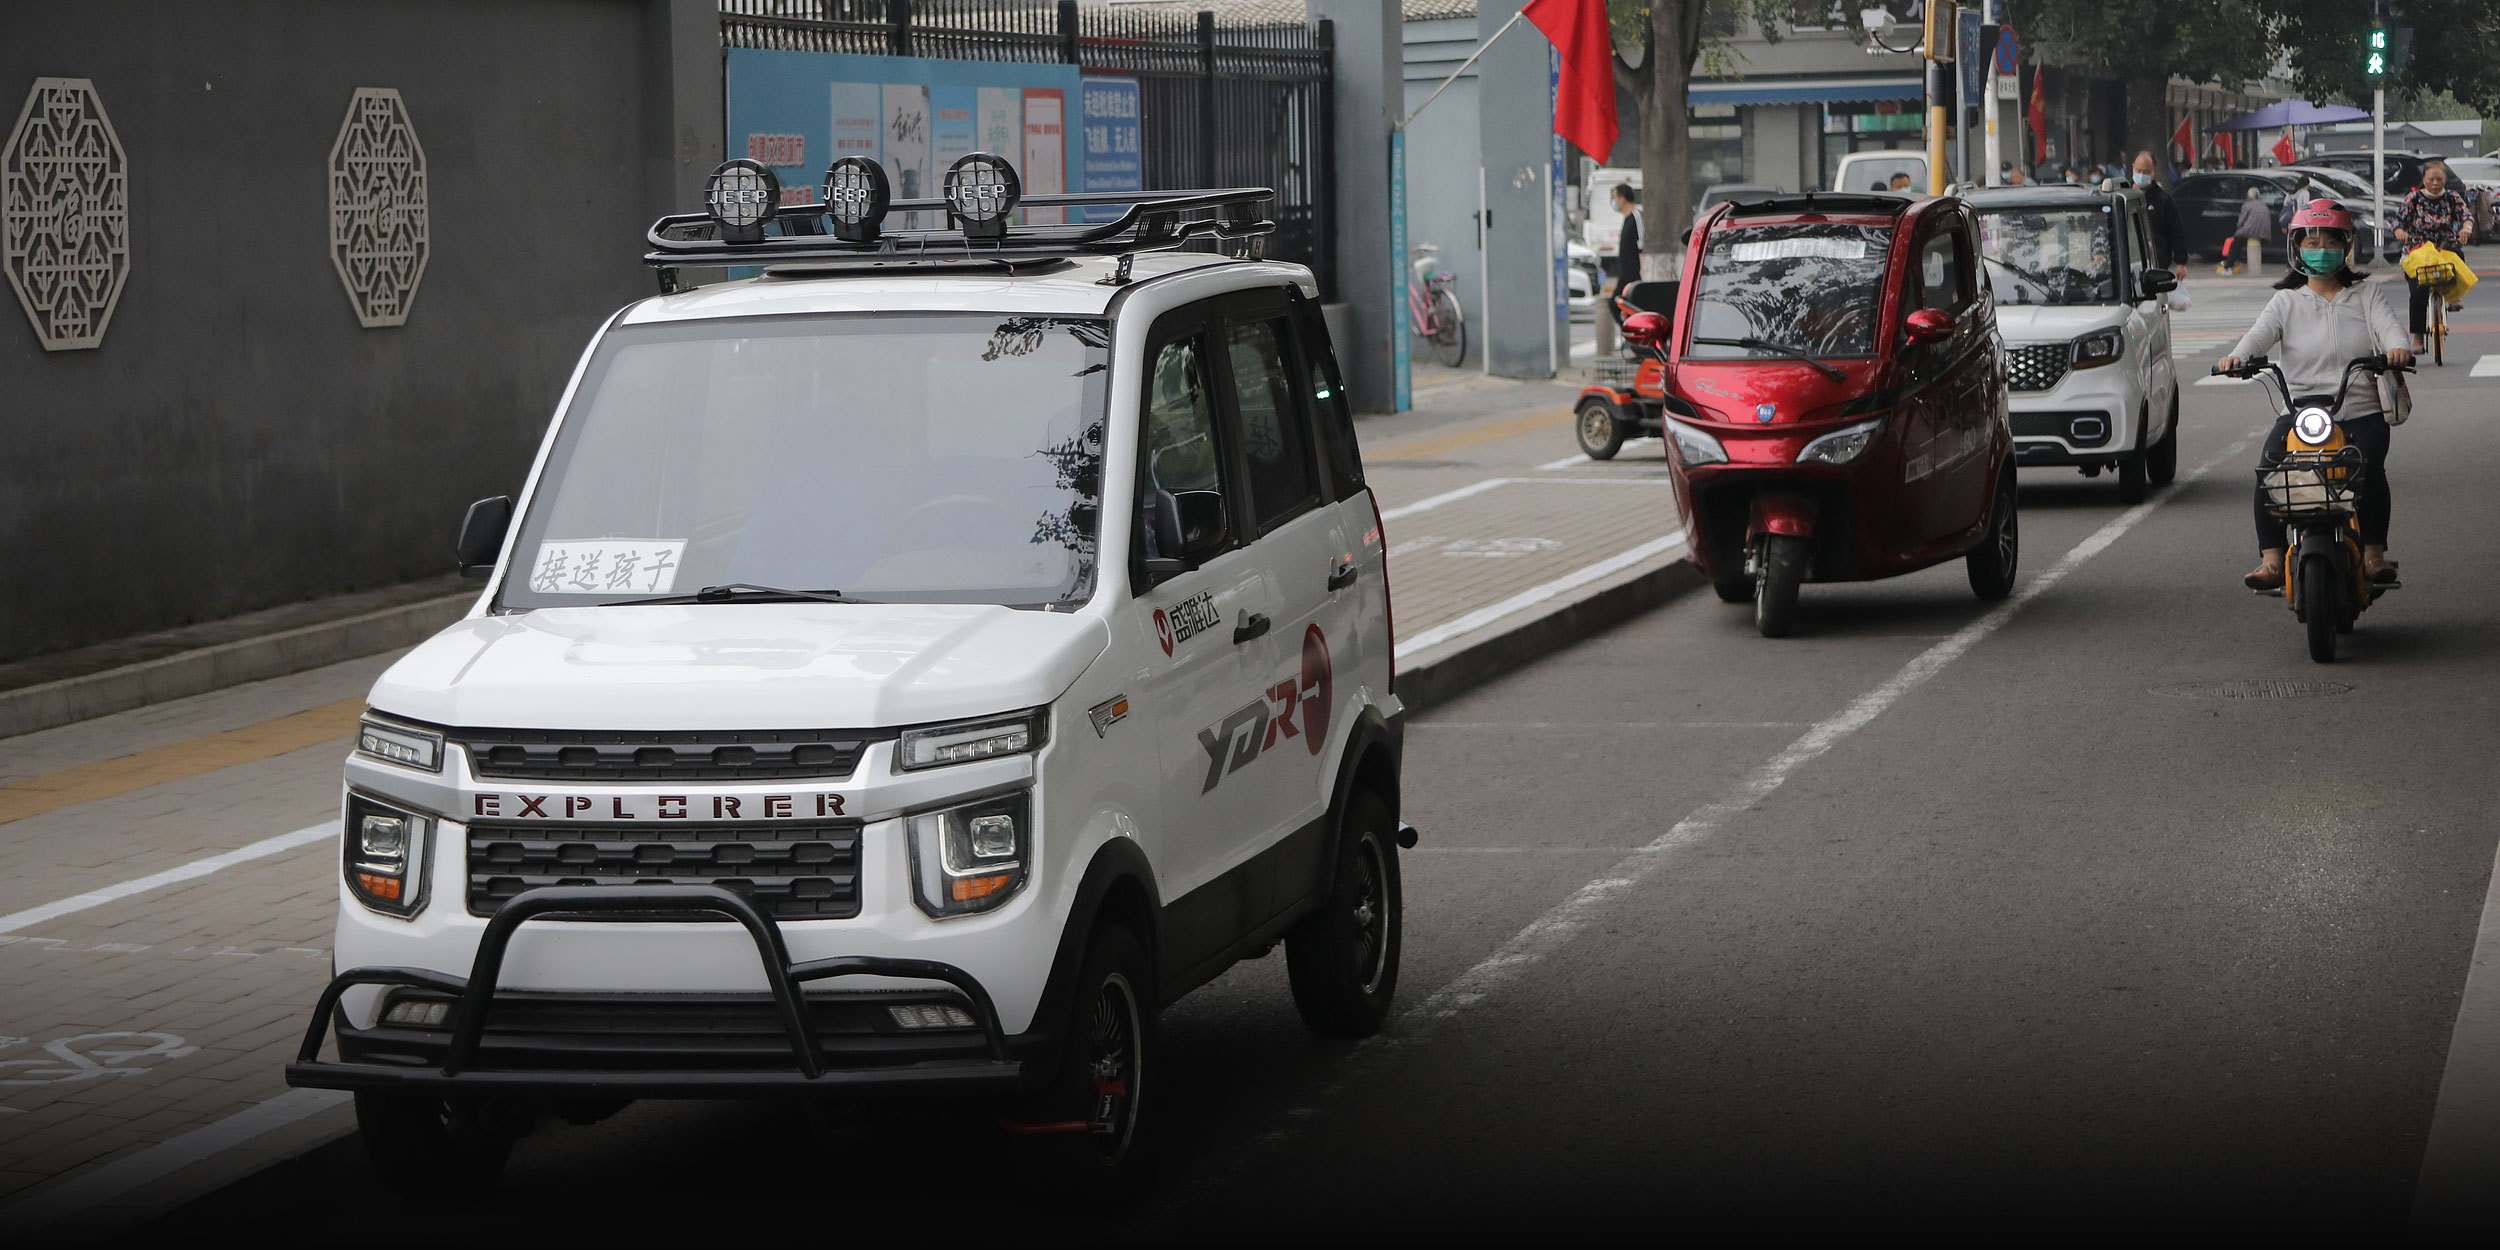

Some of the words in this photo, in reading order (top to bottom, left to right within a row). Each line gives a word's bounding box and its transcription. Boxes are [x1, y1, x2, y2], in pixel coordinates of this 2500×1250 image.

[710, 189, 767, 205] JEEP
[823, 185, 867, 203] JEEP
[949, 184, 1006, 200] JEEP
[534, 549, 675, 592] 接送孩子
[474, 793, 846, 819] EXPLORER
